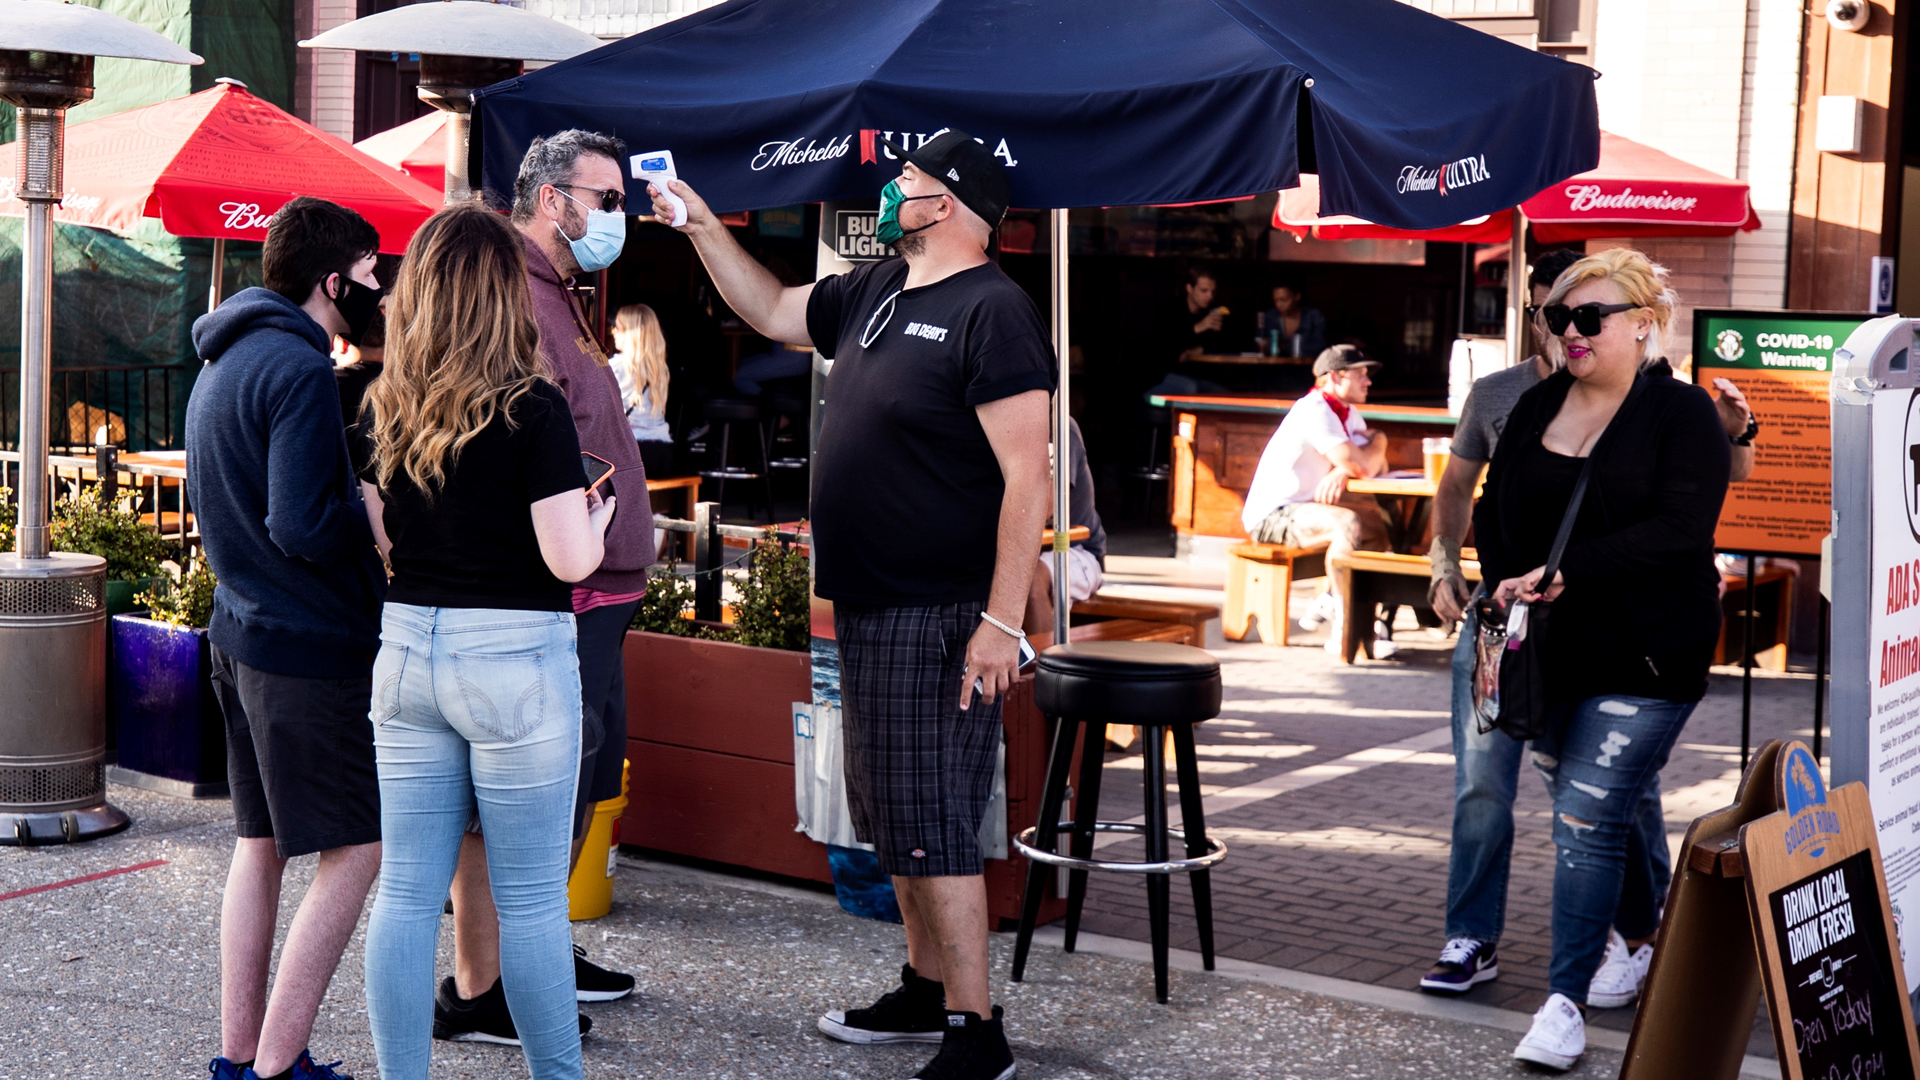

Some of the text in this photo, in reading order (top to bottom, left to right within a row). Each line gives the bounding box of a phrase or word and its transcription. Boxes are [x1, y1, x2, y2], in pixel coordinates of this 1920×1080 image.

[751, 135, 852, 171] Michelob
[1397, 153, 1490, 194] Michelob ULTRA
[1565, 184, 1698, 213] Budweiser
[847, 215, 880, 236] BU
[904, 321, 921, 336] BIG
[1756, 333, 1833, 350] COVID-19
[1761, 351, 1828, 371] Warning
[1886, 558, 1920, 616] ADA S
[1784, 810, 1841, 855] GOLDEN ROAD
[1783, 881, 1818, 929] DRINK
[1816, 868, 1850, 913] LOCAL
[1787, 918, 1822, 966] DRINK
[1820, 902, 1855, 948] FRESH
